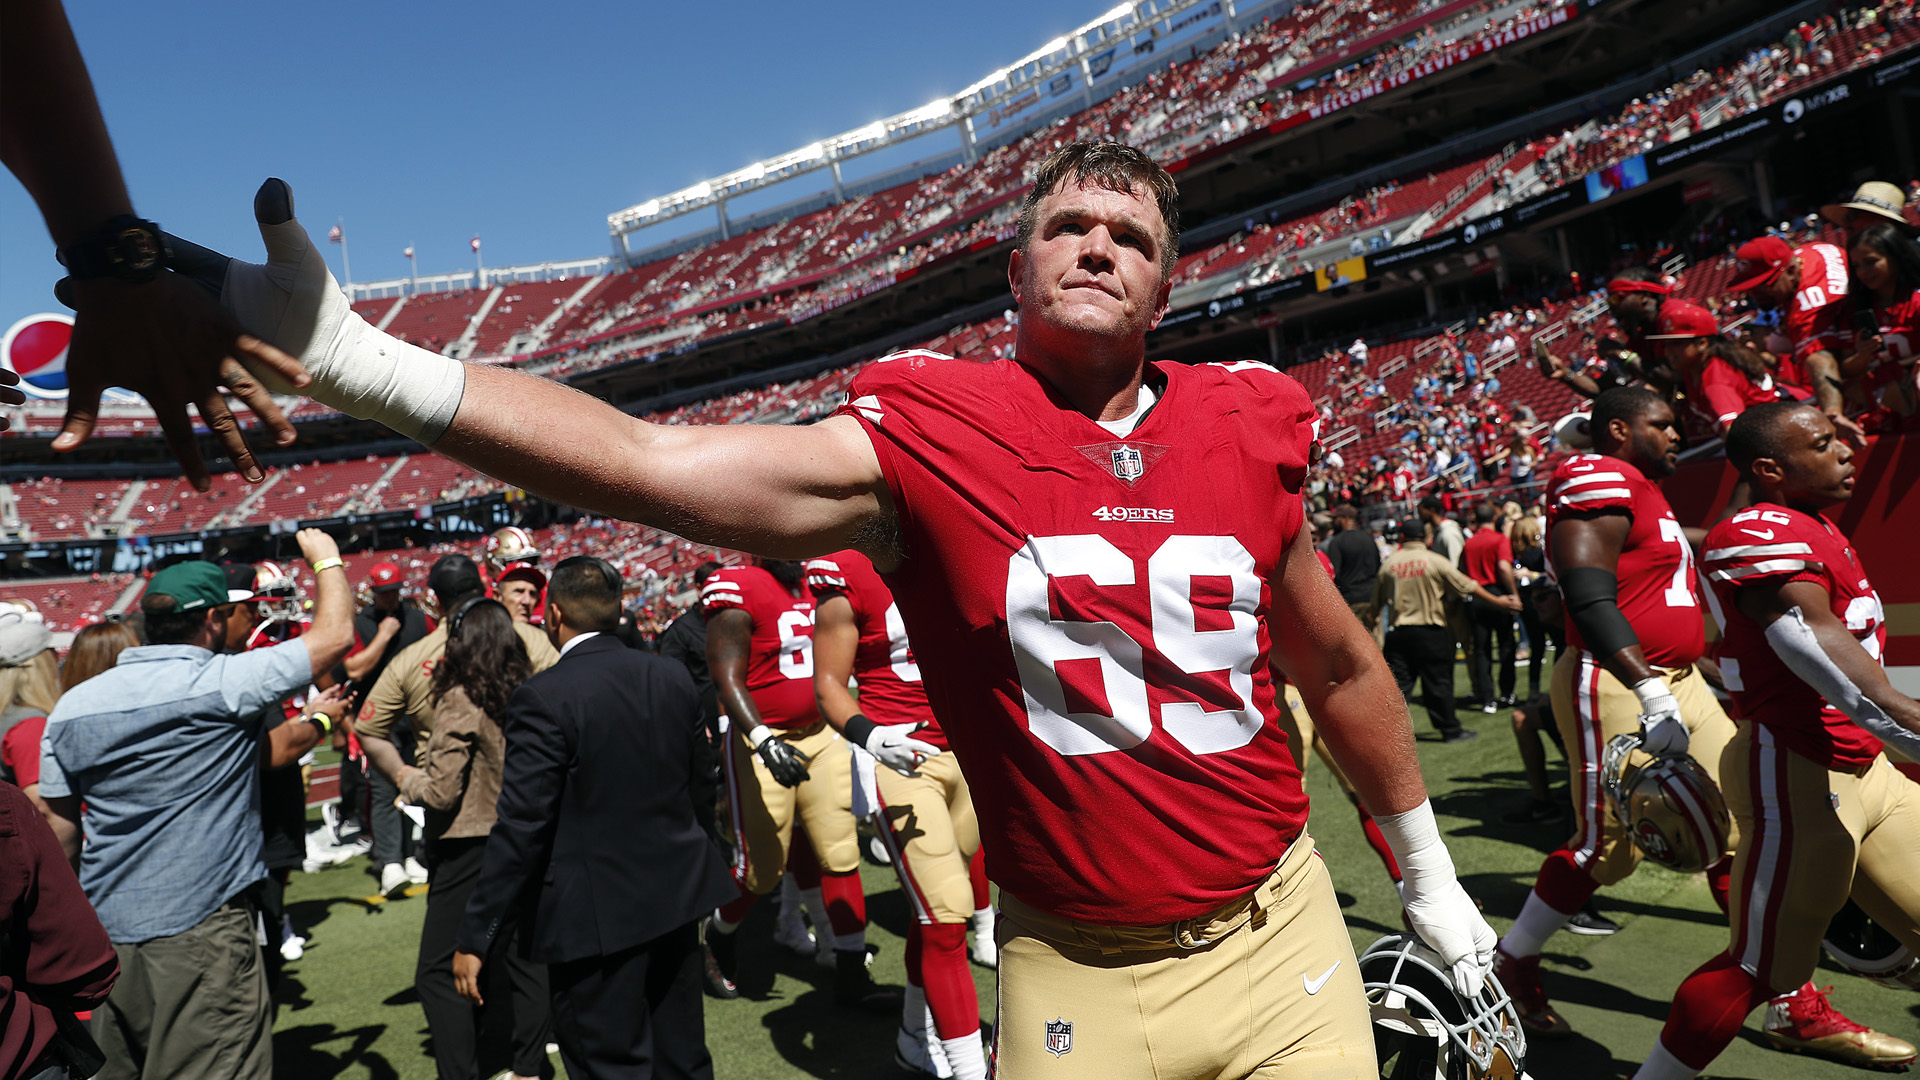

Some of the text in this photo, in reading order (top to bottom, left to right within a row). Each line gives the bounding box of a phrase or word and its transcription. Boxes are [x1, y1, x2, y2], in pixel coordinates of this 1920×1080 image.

[1309, 82, 1385, 119] WELCOME
[1390, 71, 1411, 89] TO
[1482, 8, 1568, 52] STADIUM
[1796, 286, 1827, 312] 10
[1092, 506, 1175, 523] 49ERS
[777, 610, 816, 680] 6
[1006, 534, 1265, 755] 69
[1049, 1034, 1069, 1050] NFL
